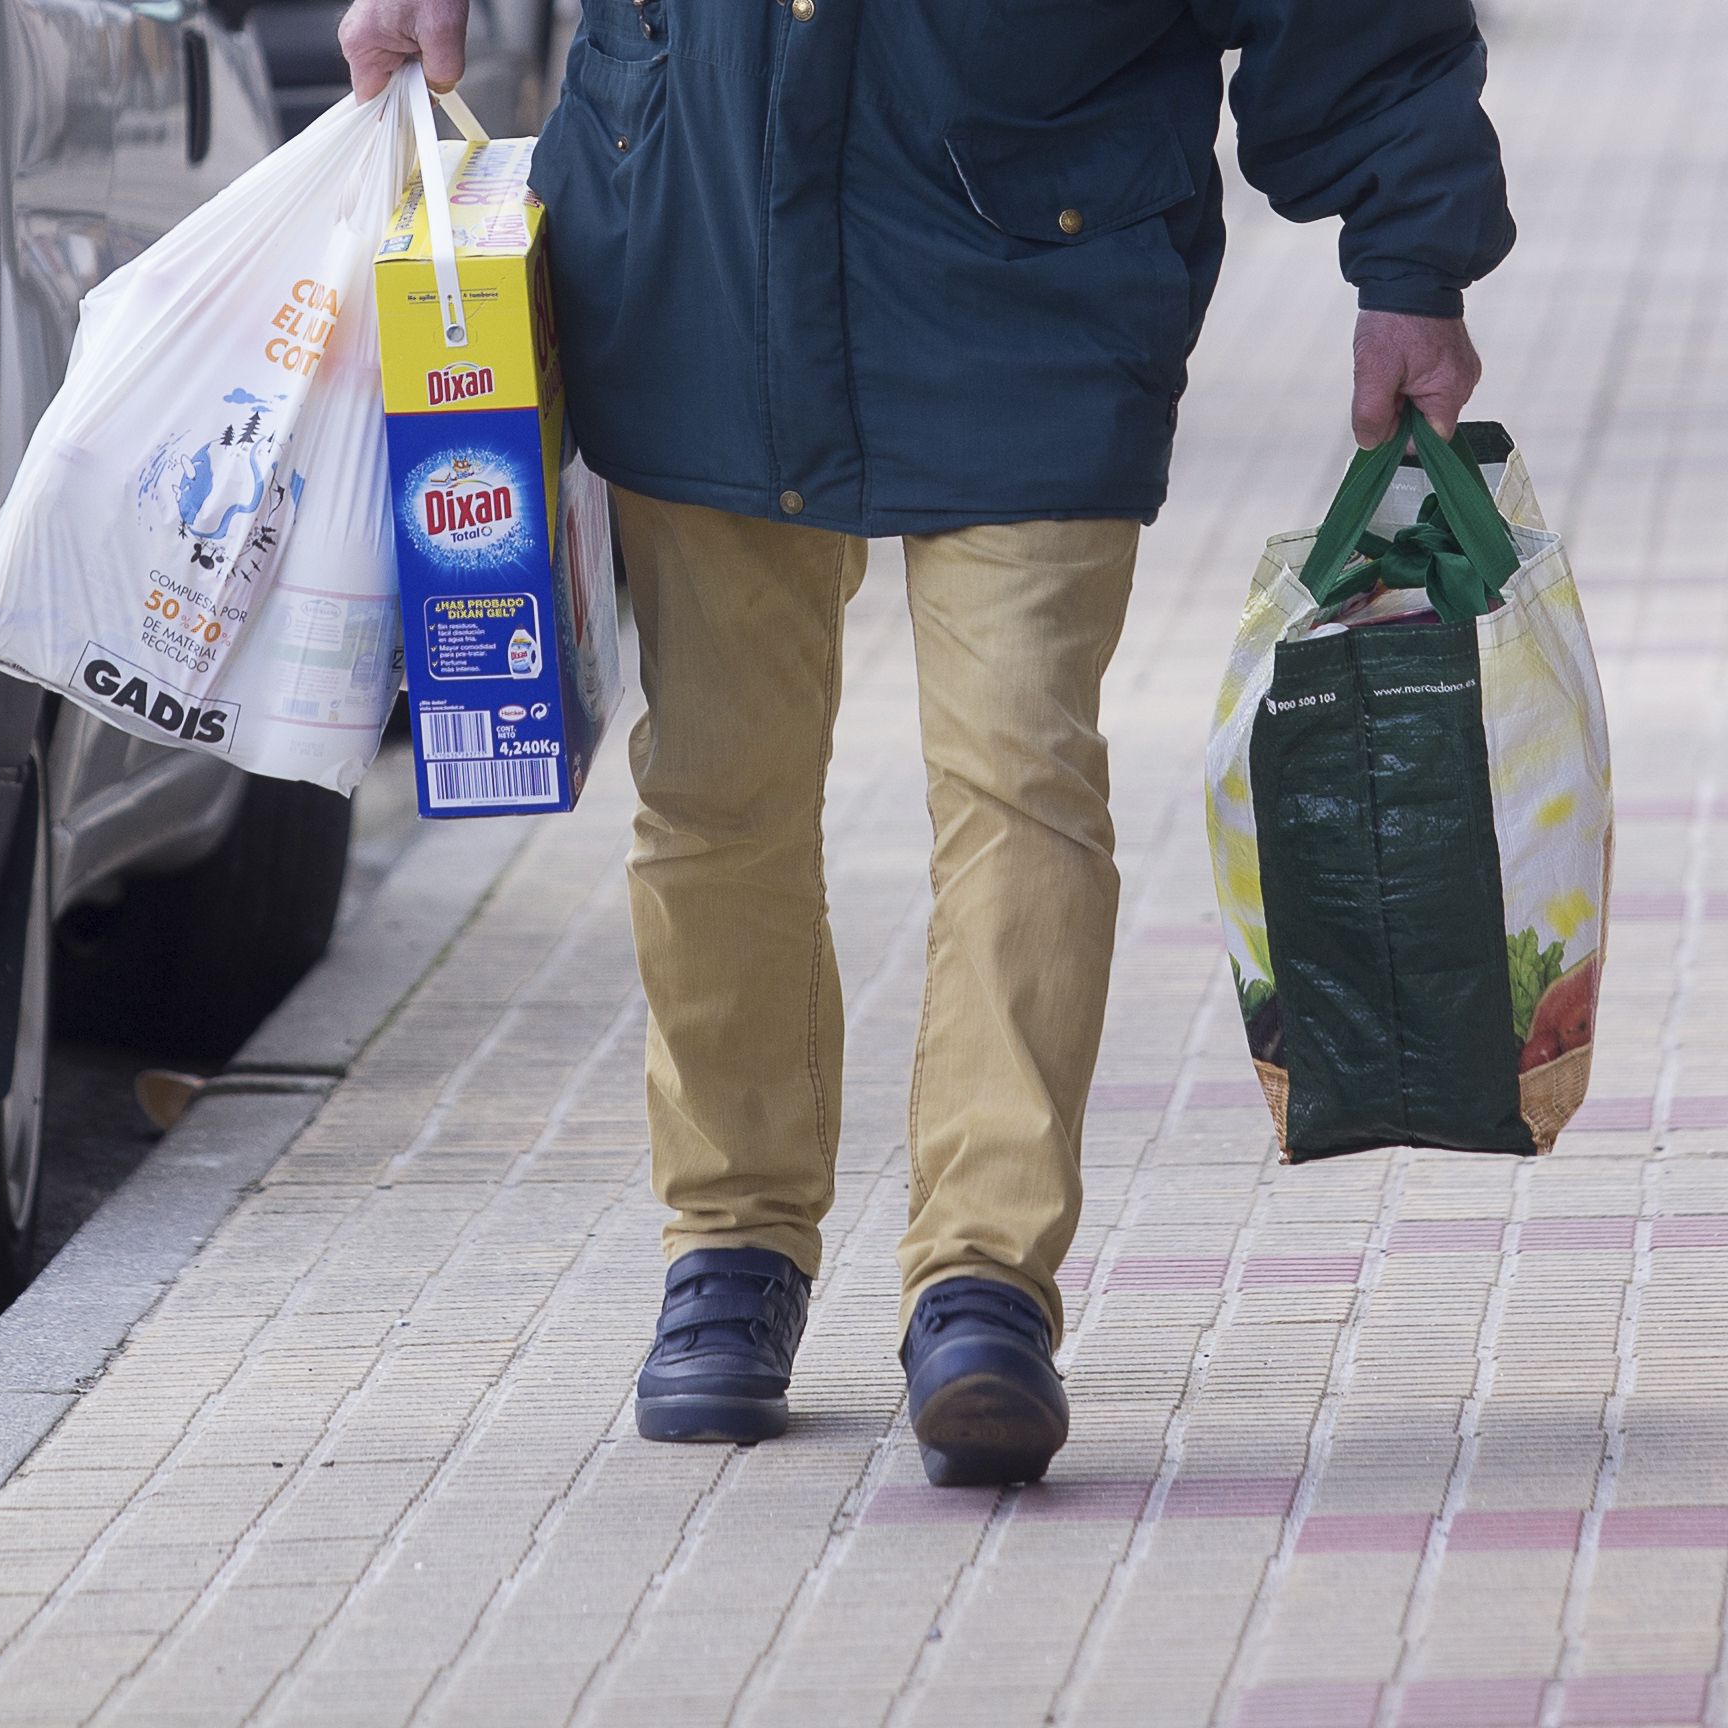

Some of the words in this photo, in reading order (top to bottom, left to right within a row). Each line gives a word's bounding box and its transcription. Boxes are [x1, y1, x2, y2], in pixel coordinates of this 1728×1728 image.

[272, 303, 305, 337] EL
[427, 367, 494, 405] Dixan
[425, 485, 512, 536] Dixan
[450, 526, 480, 544] Total
[220, 606, 248, 623] POR
[435, 600, 464, 612] ¿HAS
[467, 598, 524, 609] PROBADO
[448, 608, 484, 620] DIXAN
[487, 607, 516, 618] GEL?
[143, 616, 162, 633] DE
[162, 627, 217, 661] MATERIAL
[141, 631, 210, 673] RECICLADO
[1373, 678, 1476, 698] www.mercadona.es
[84, 659, 228, 743] GADIS
[1277, 700, 1296, 713] 900
[1298, 695, 1317, 708] 500
[1319, 692, 1336, 705] 103
[496, 725, 517, 733] CONT.
[499, 739, 560, 757] 4,240Kg
